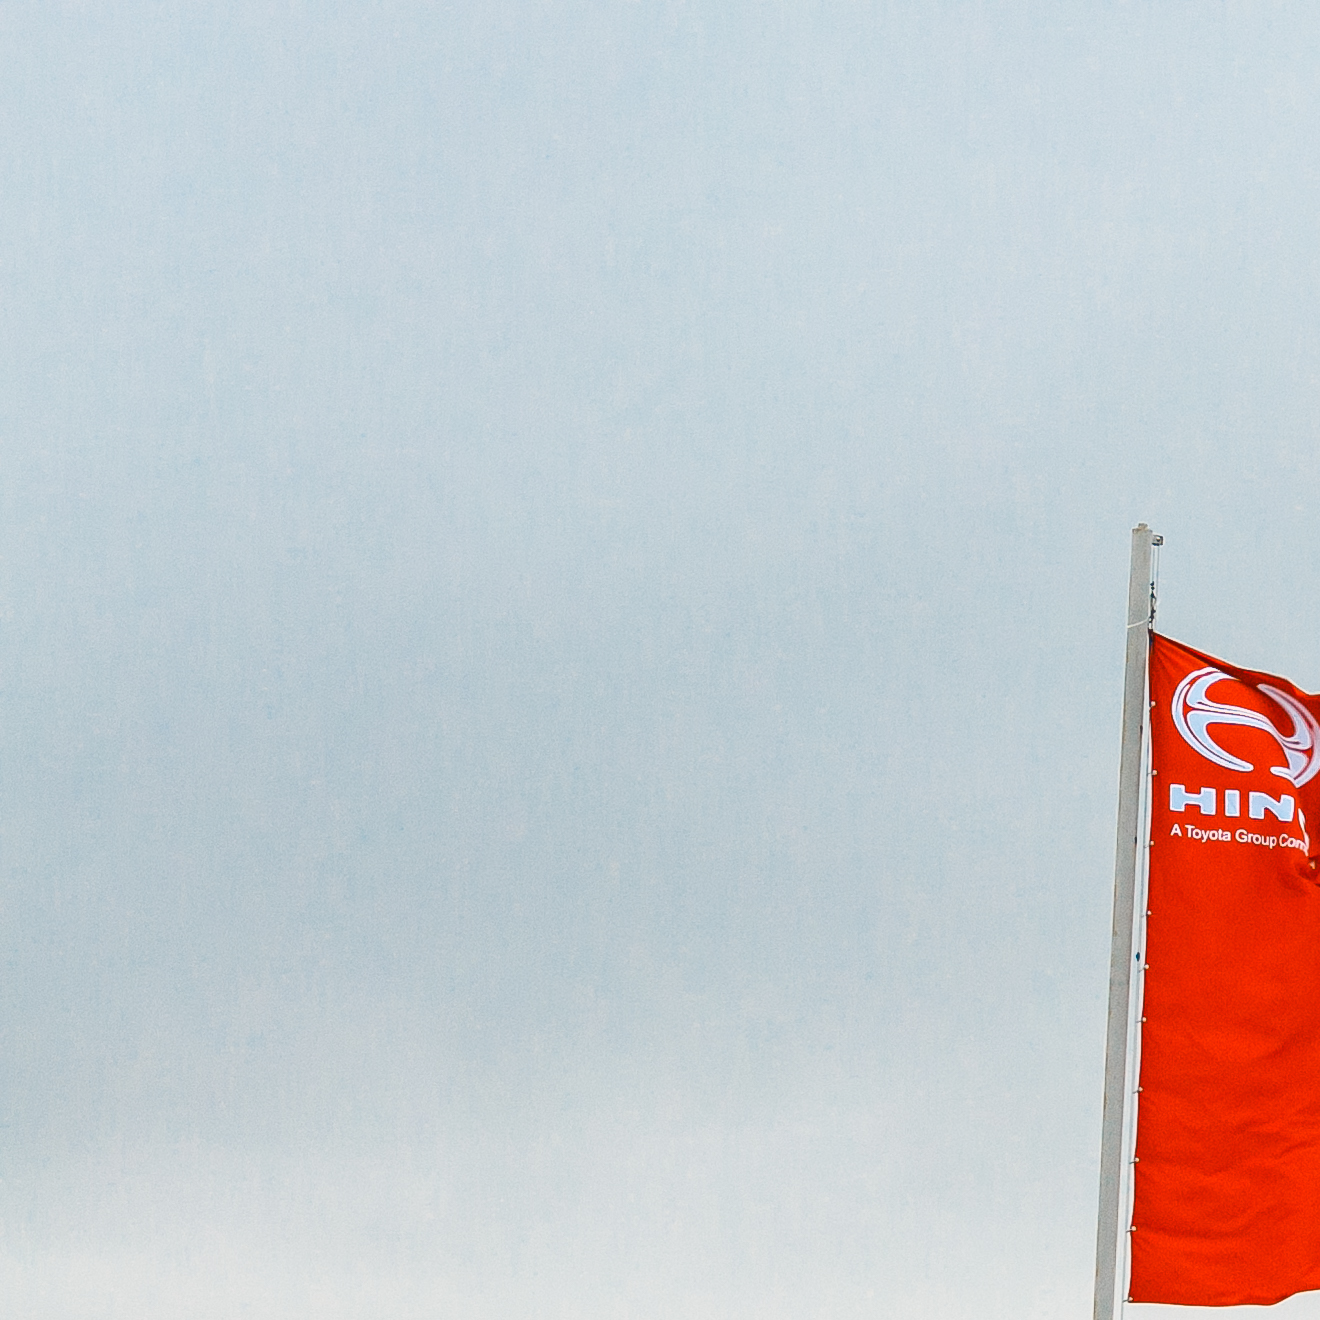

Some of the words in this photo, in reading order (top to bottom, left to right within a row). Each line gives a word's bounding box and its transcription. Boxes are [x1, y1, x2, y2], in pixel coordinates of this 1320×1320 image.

[1169, 783, 1306, 834] HIN
[1170, 823, 1182, 837] A
[1184, 824, 1231, 843] Toyota
[1235, 829, 1277, 849] Group
